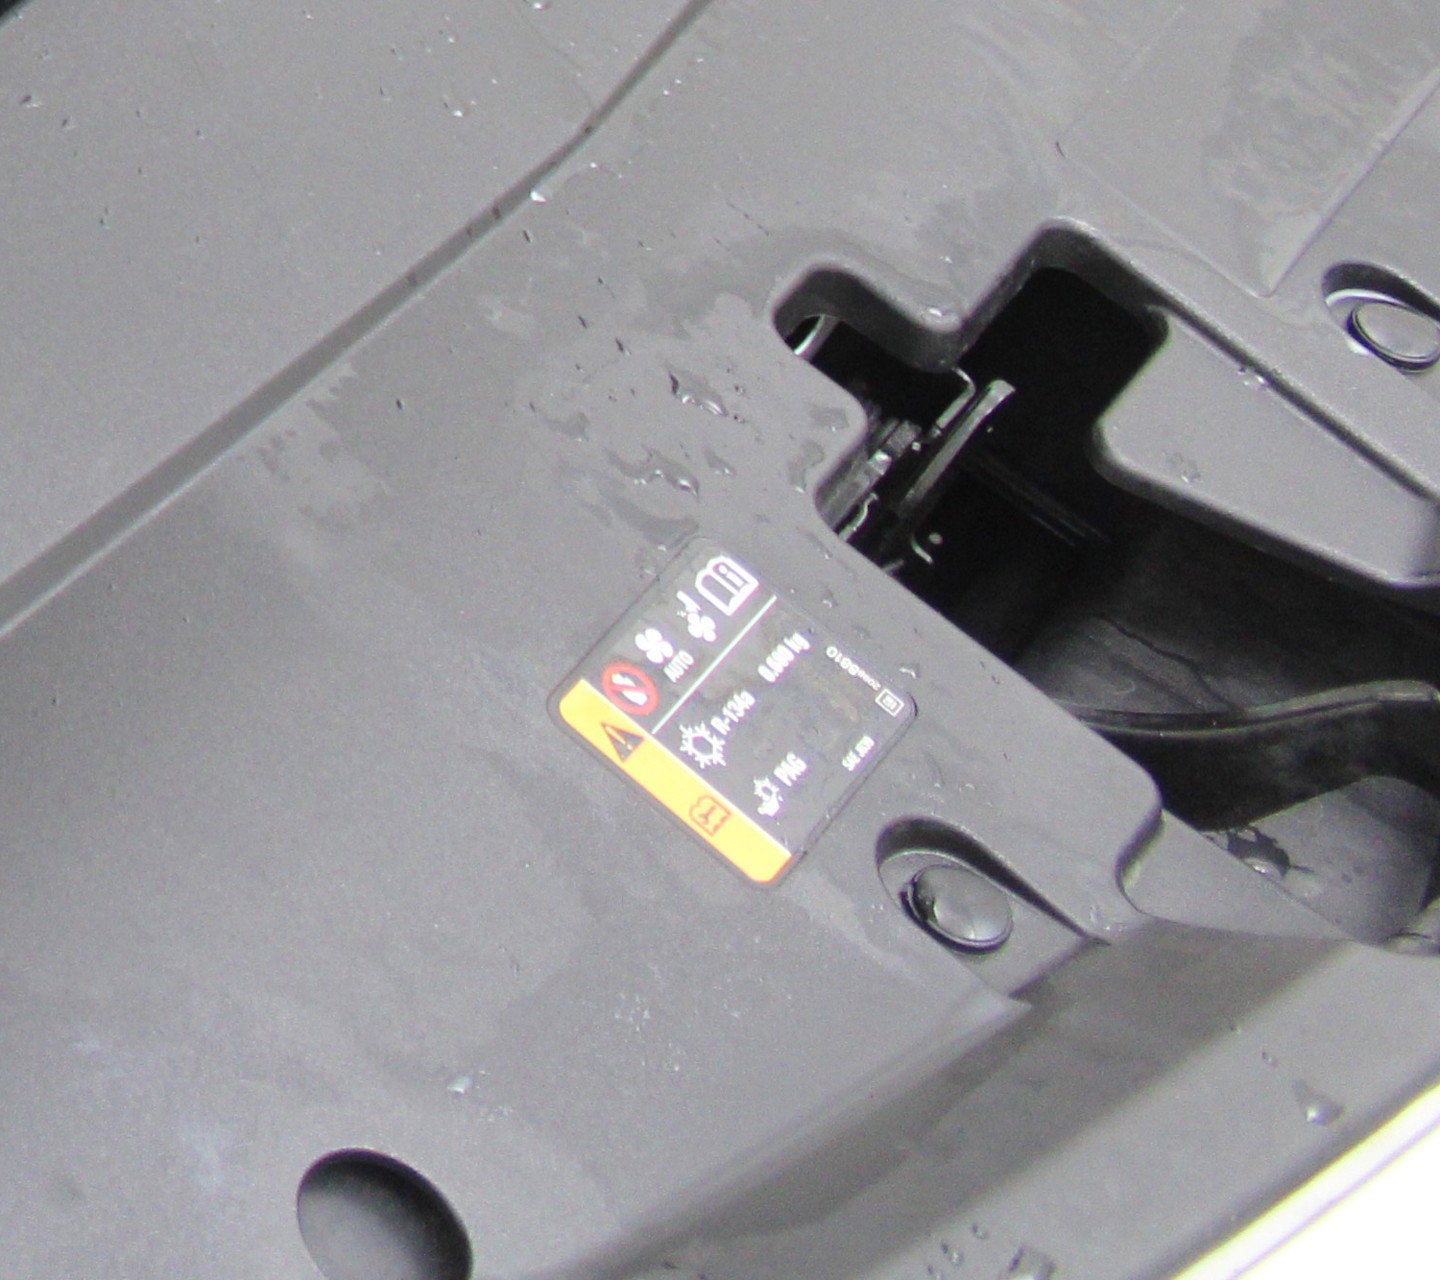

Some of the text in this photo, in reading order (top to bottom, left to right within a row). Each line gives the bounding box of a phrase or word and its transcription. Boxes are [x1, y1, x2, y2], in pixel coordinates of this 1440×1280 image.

[663, 651, 695, 684] AUTO
[709, 689, 757, 737] R-134a
[774, 751, 808, 787] PAG
